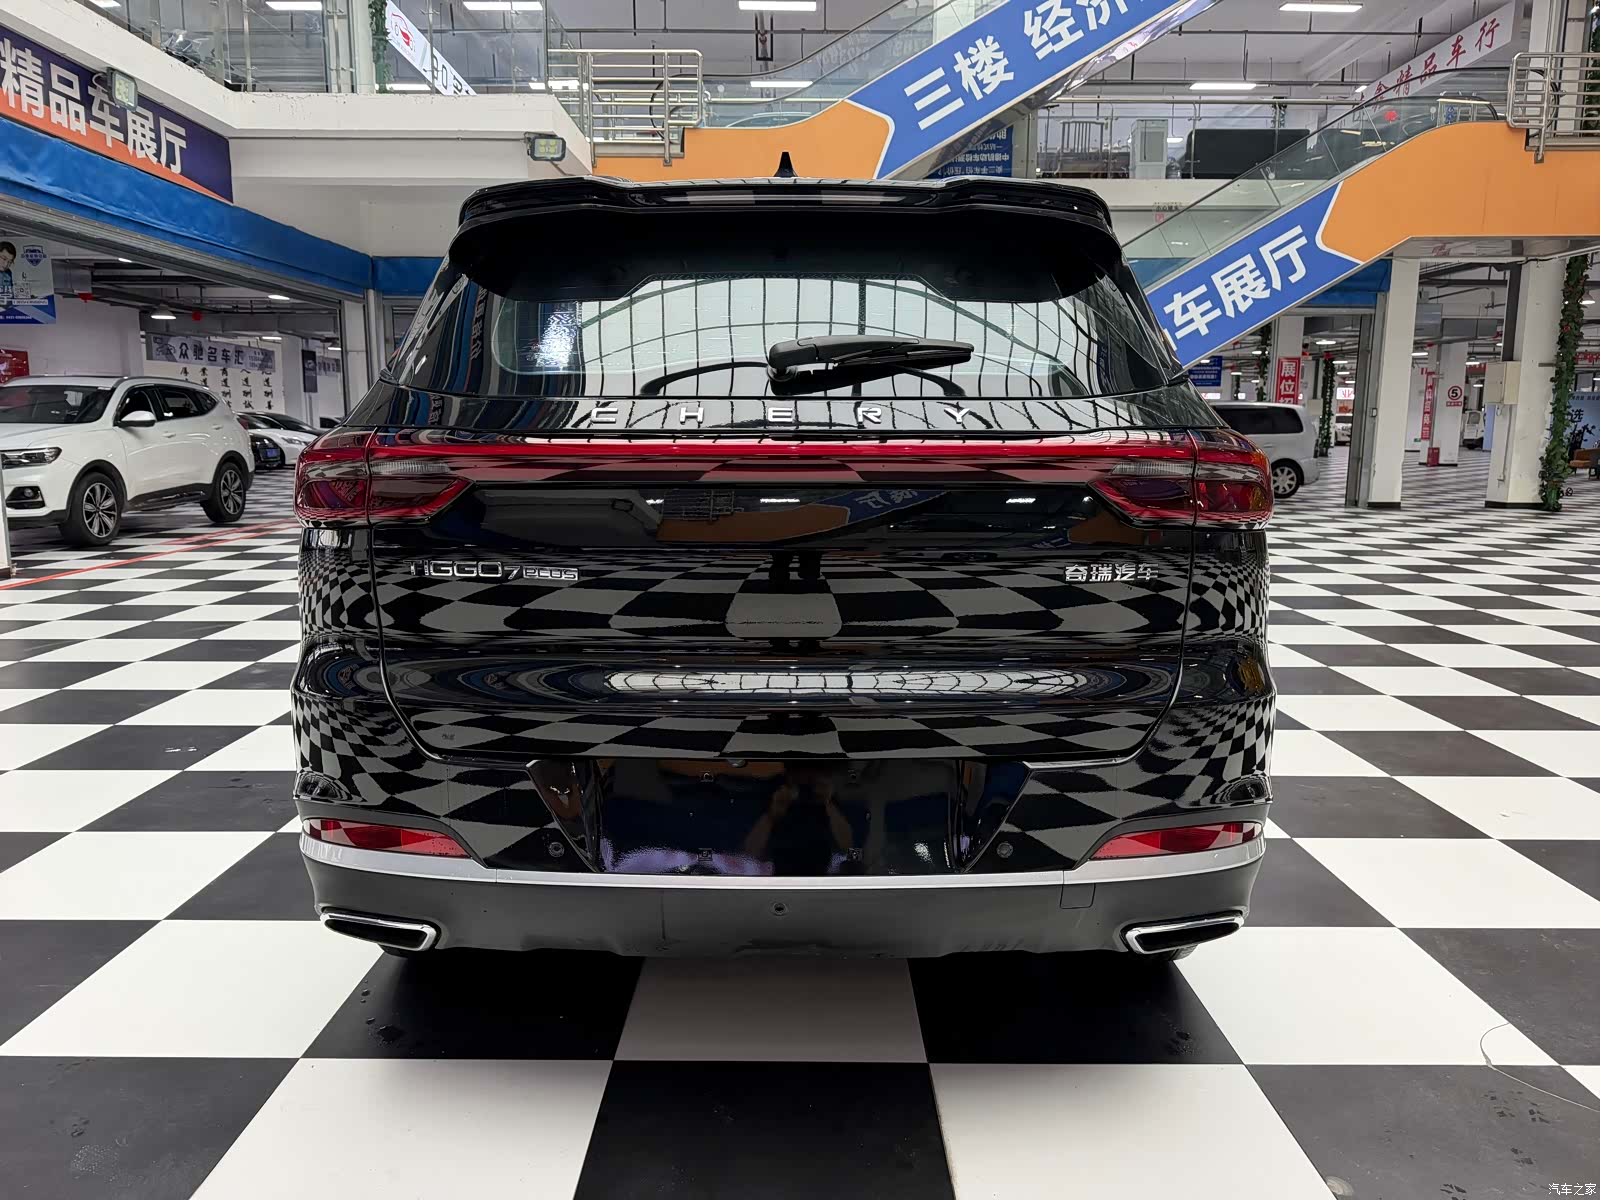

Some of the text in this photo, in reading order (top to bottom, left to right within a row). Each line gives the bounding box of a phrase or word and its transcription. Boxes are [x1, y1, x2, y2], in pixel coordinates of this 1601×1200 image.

[904, 35, 1015, 130] 三楼
[0, 38, 187, 175] 精品车展厅
[1163, 225, 1308, 351] 车展厅
[1451, 389, 1458, 398] 5
[591, 407, 971, 424] CHERY
[402, 559, 579, 581] TIGGO 7 PLUS
[1065, 563, 1159, 582] 奇瑞汽车
